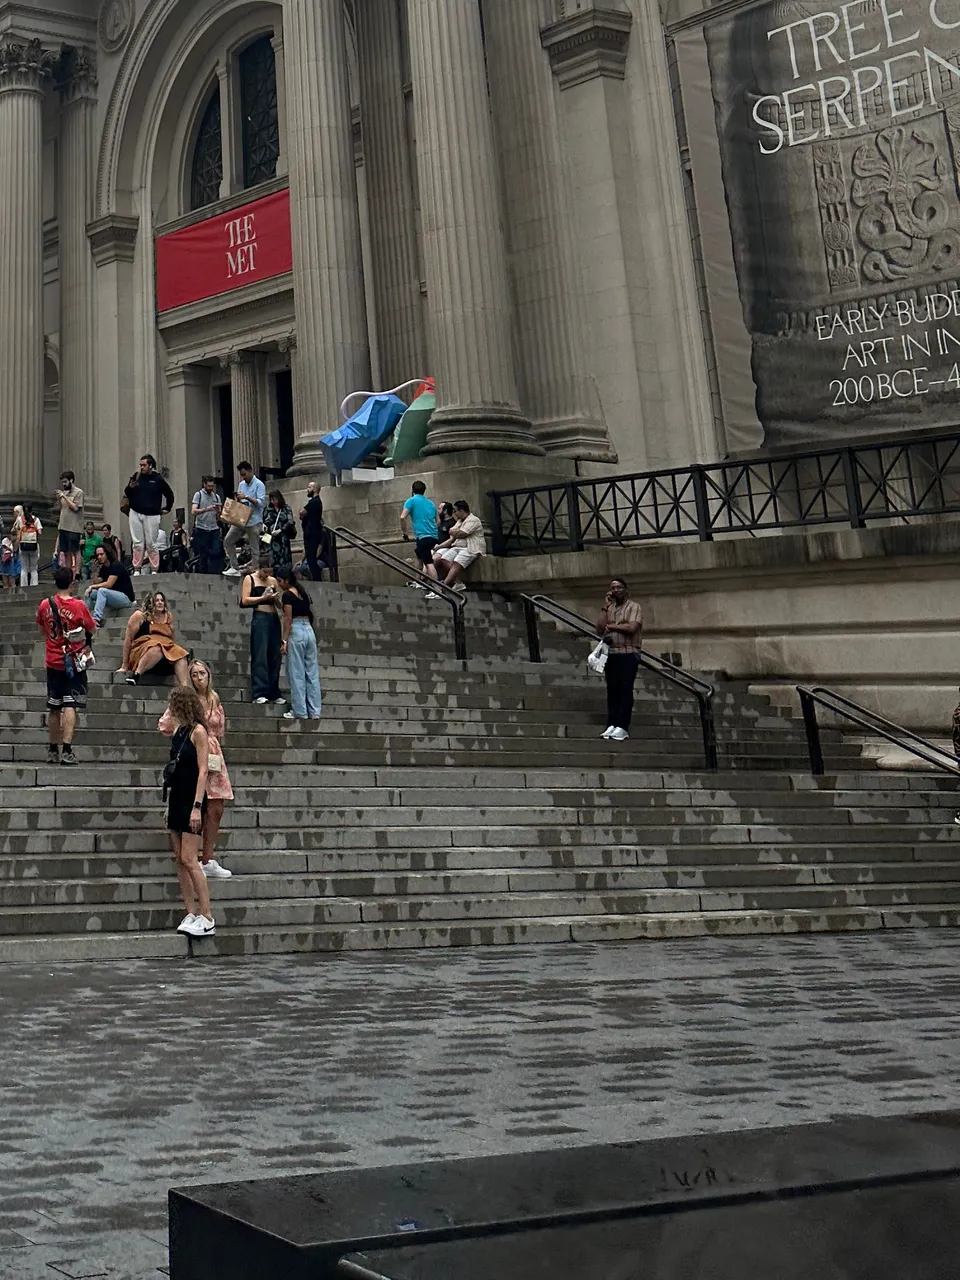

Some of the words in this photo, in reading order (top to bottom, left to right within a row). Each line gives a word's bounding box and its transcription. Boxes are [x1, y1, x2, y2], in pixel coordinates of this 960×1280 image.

[224, 213, 257, 248] THE
[225, 242, 259, 279] MET
[815, 303, 889, 341] EARLY
[841, 336, 895, 371] ART
[901, 331, 932, 361] IN
